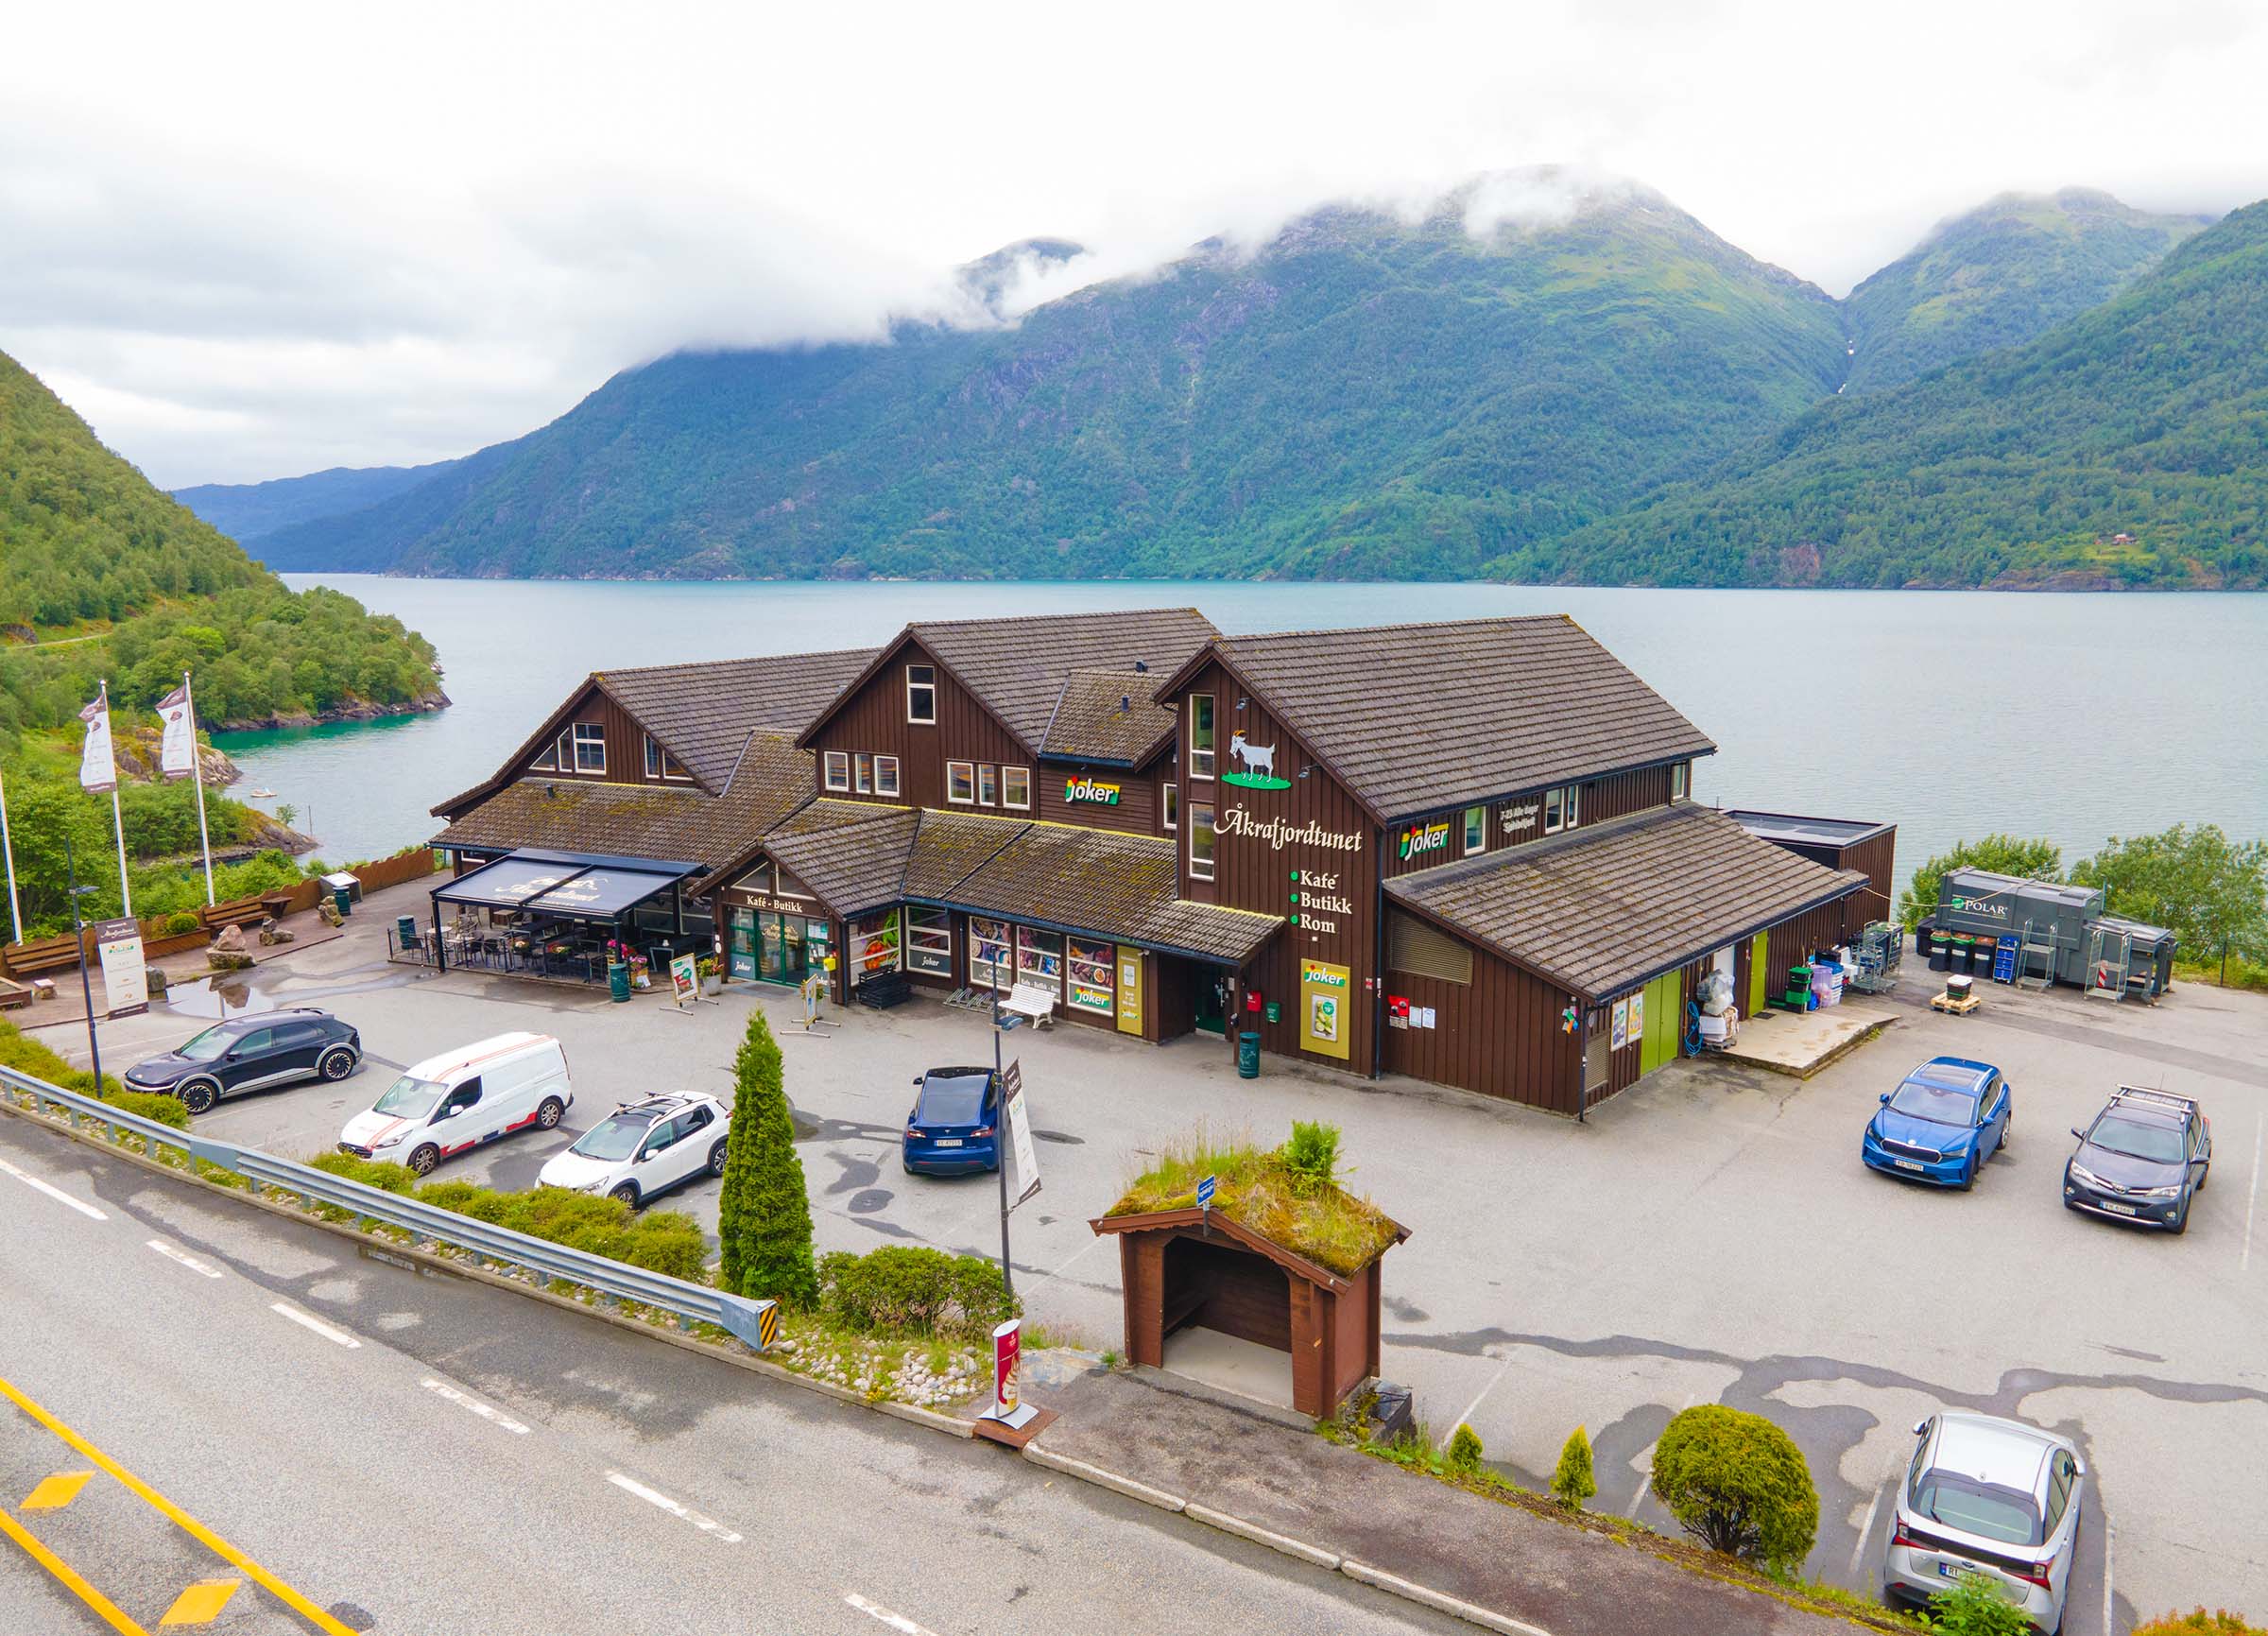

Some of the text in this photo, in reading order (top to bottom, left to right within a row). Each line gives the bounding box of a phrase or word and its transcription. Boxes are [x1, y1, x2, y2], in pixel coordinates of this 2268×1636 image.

[1066, 776, 1114, 802] joker
[1213, 802, 1363, 852] Åkrafjordtunet
[1404, 823, 1448, 861] joker
[1300, 870, 1339, 889] Kafé
[747, 895, 766, 907] Kafé
[773, 899, 802, 913] Butikk
[1300, 892, 1352, 914] Butikk
[1300, 914, 1336, 934] Rom
[735, 961, 751, 971] joker
[921, 956, 939, 967] joker
[1305, 964, 1343, 985] joker
[1076, 987, 1107, 1006] joker
